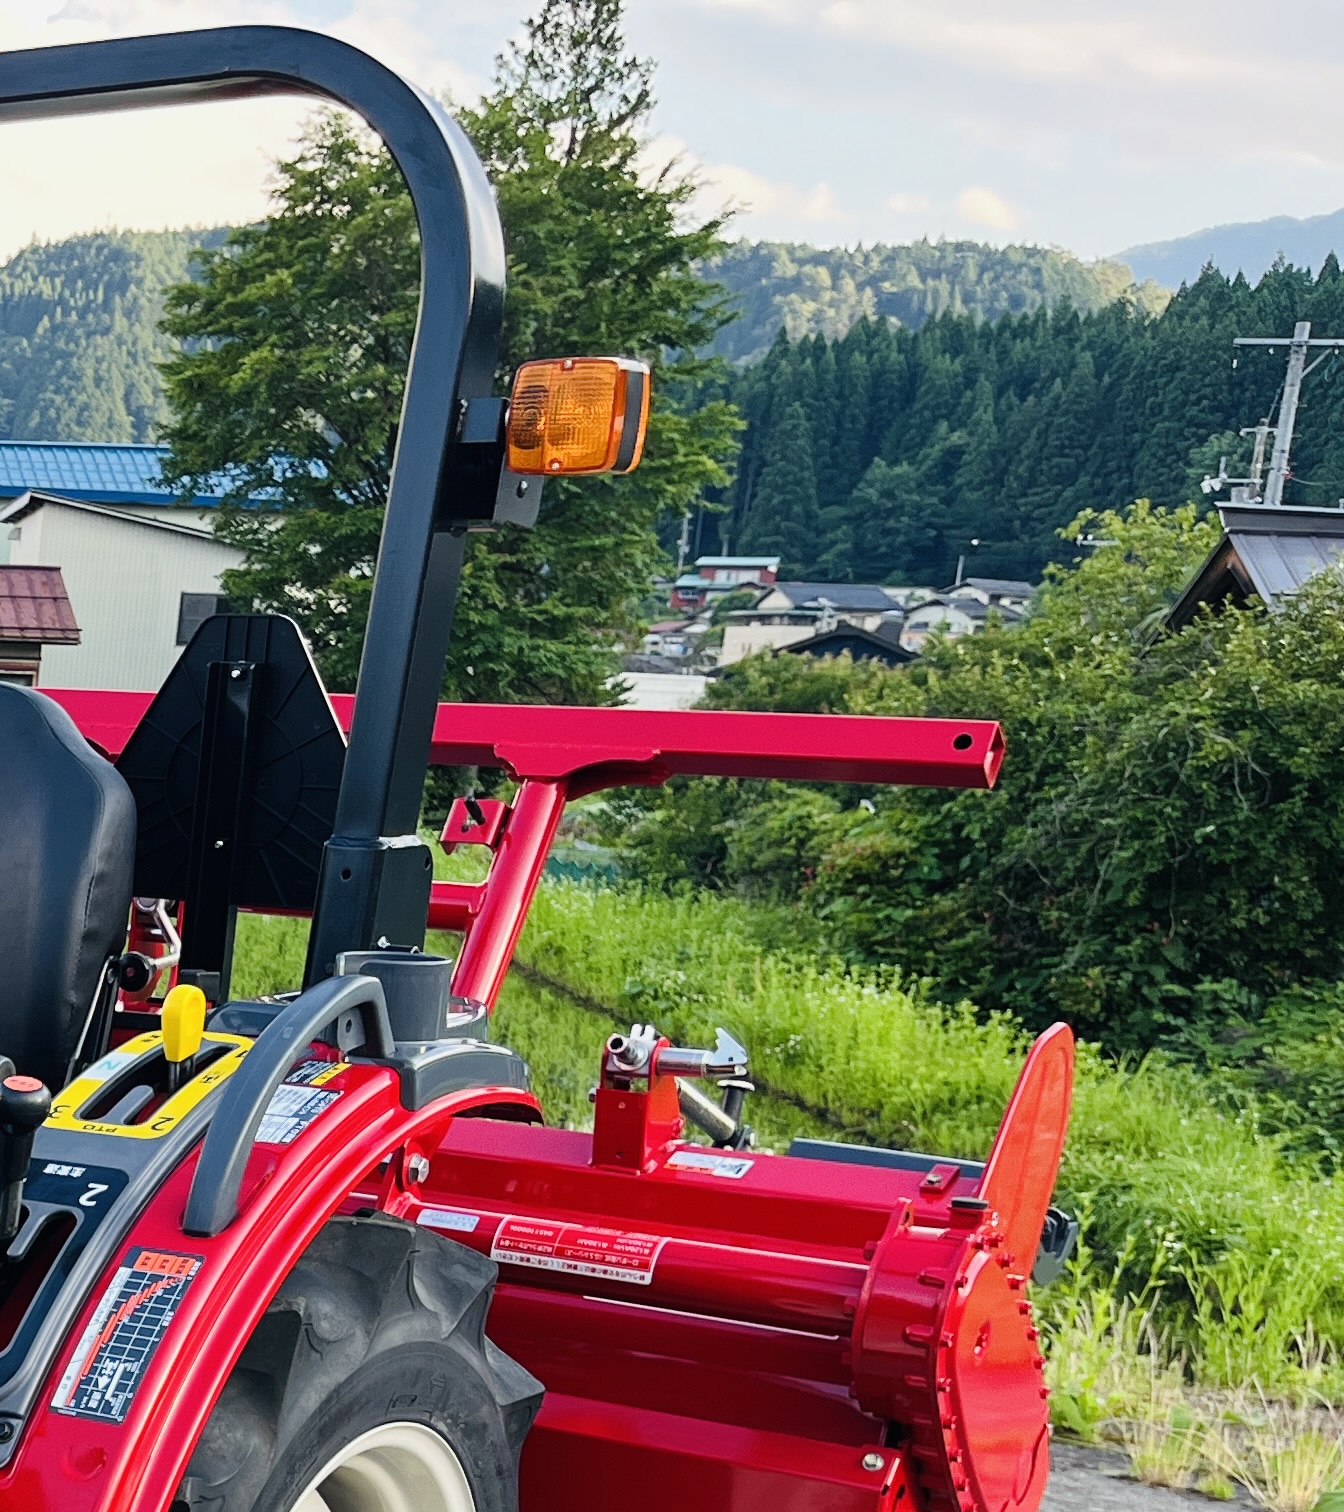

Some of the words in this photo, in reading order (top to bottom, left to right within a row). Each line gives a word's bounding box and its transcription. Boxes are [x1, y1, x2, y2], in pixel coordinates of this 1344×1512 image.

[82, 1123, 118, 1134] PTO
[150, 1116, 175, 1132] 2
[78, 1182, 110, 1208] 2
